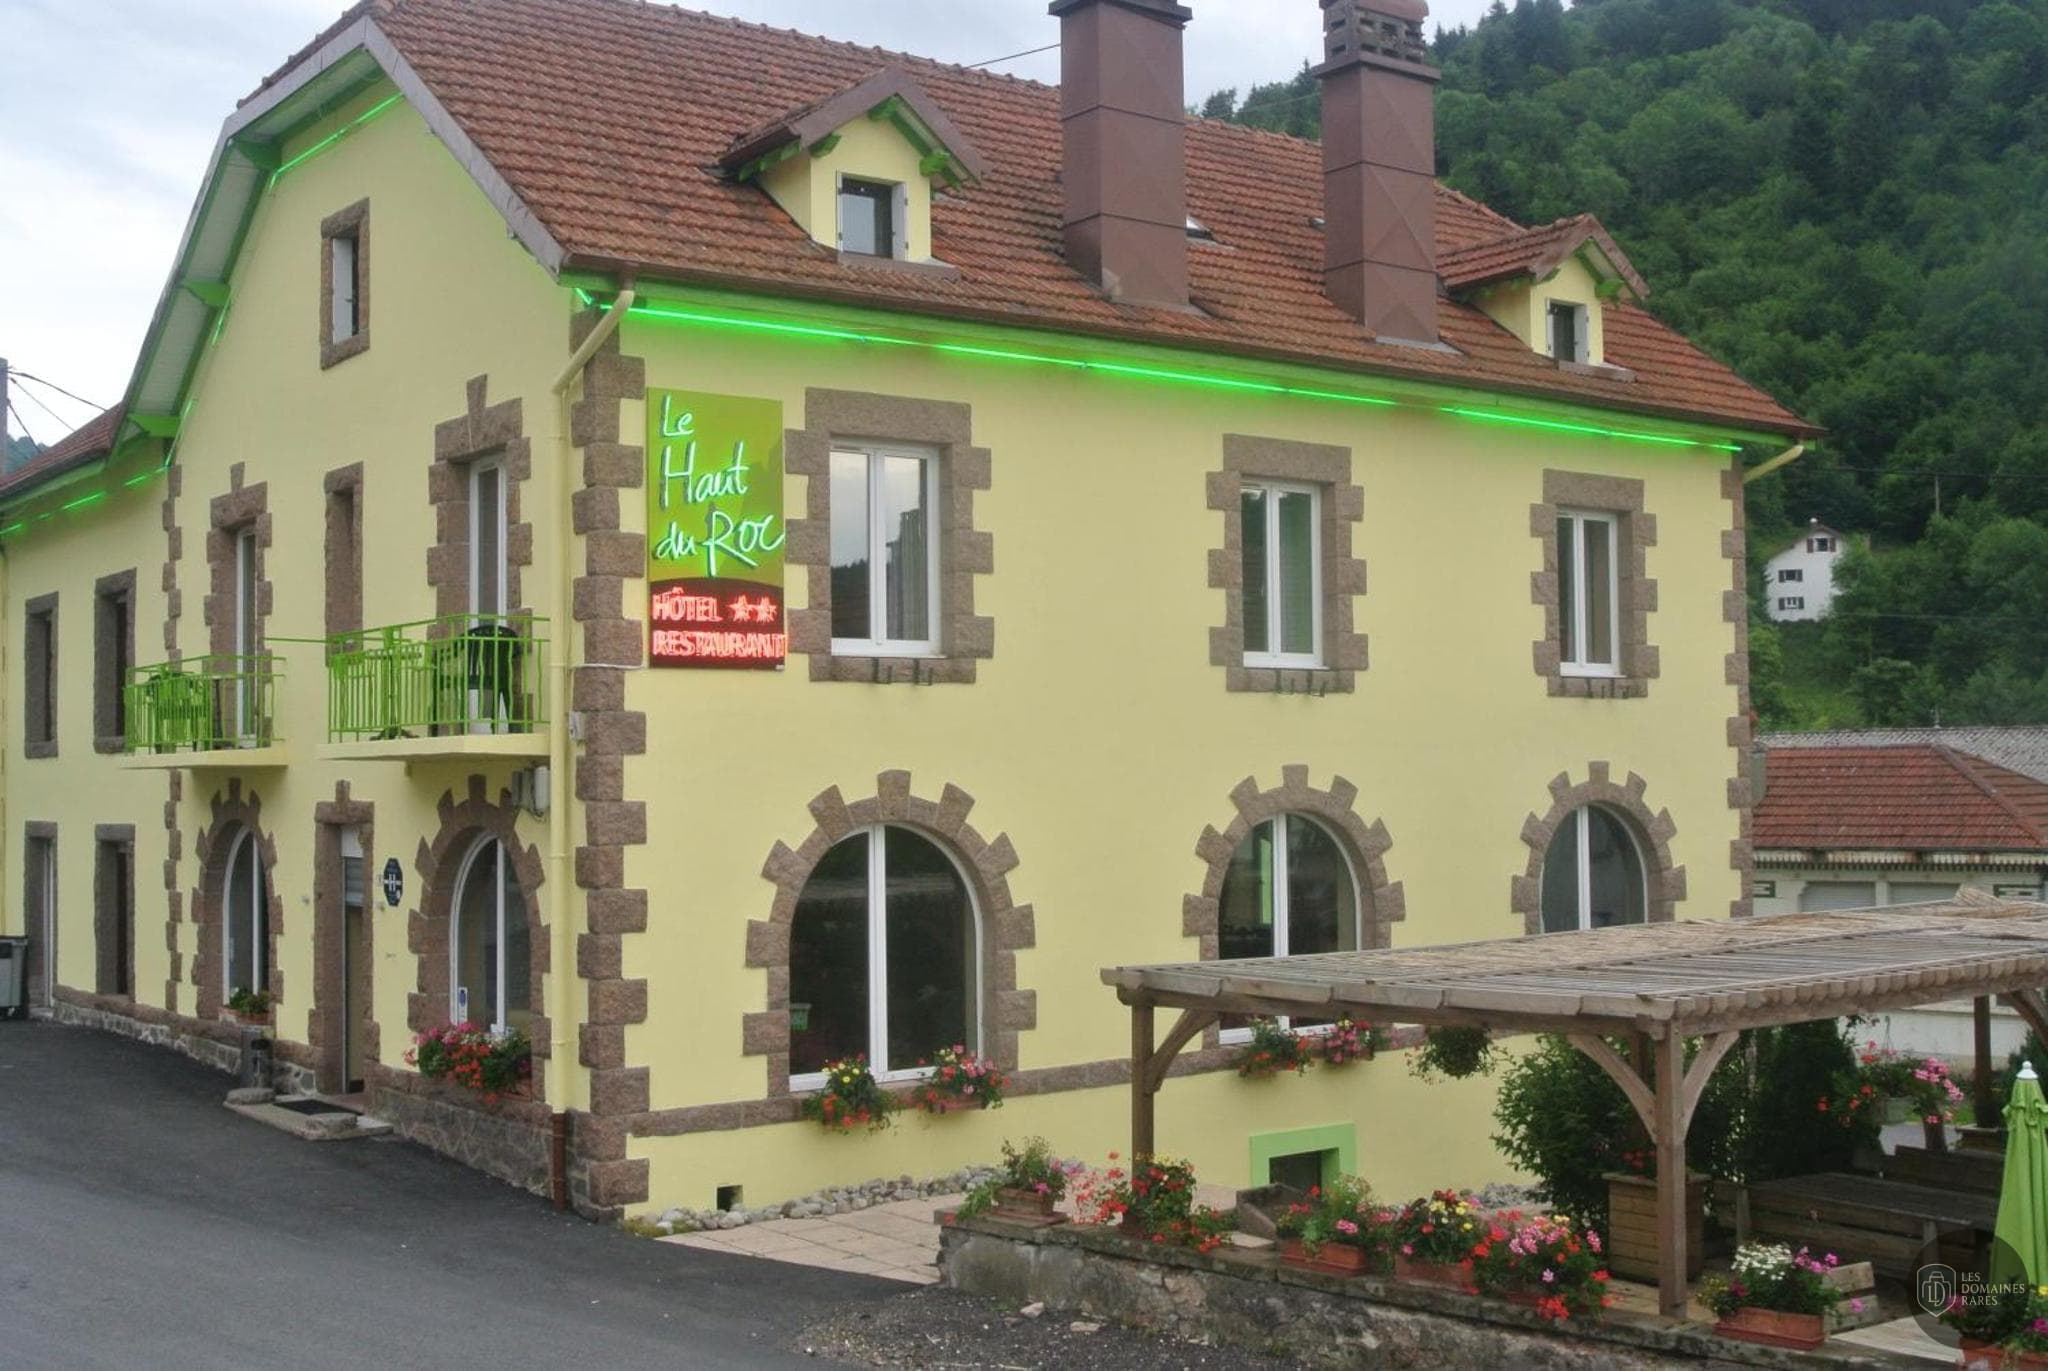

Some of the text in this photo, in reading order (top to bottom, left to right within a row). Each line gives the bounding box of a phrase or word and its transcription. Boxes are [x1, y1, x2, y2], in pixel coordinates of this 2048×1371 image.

[662, 395, 695, 437] Le
[661, 441, 749, 508] Haut
[655, 510, 785, 577] du Roc
[652, 587, 723, 622] HÔTEL
[652, 630, 788, 658] RESTAURANT
